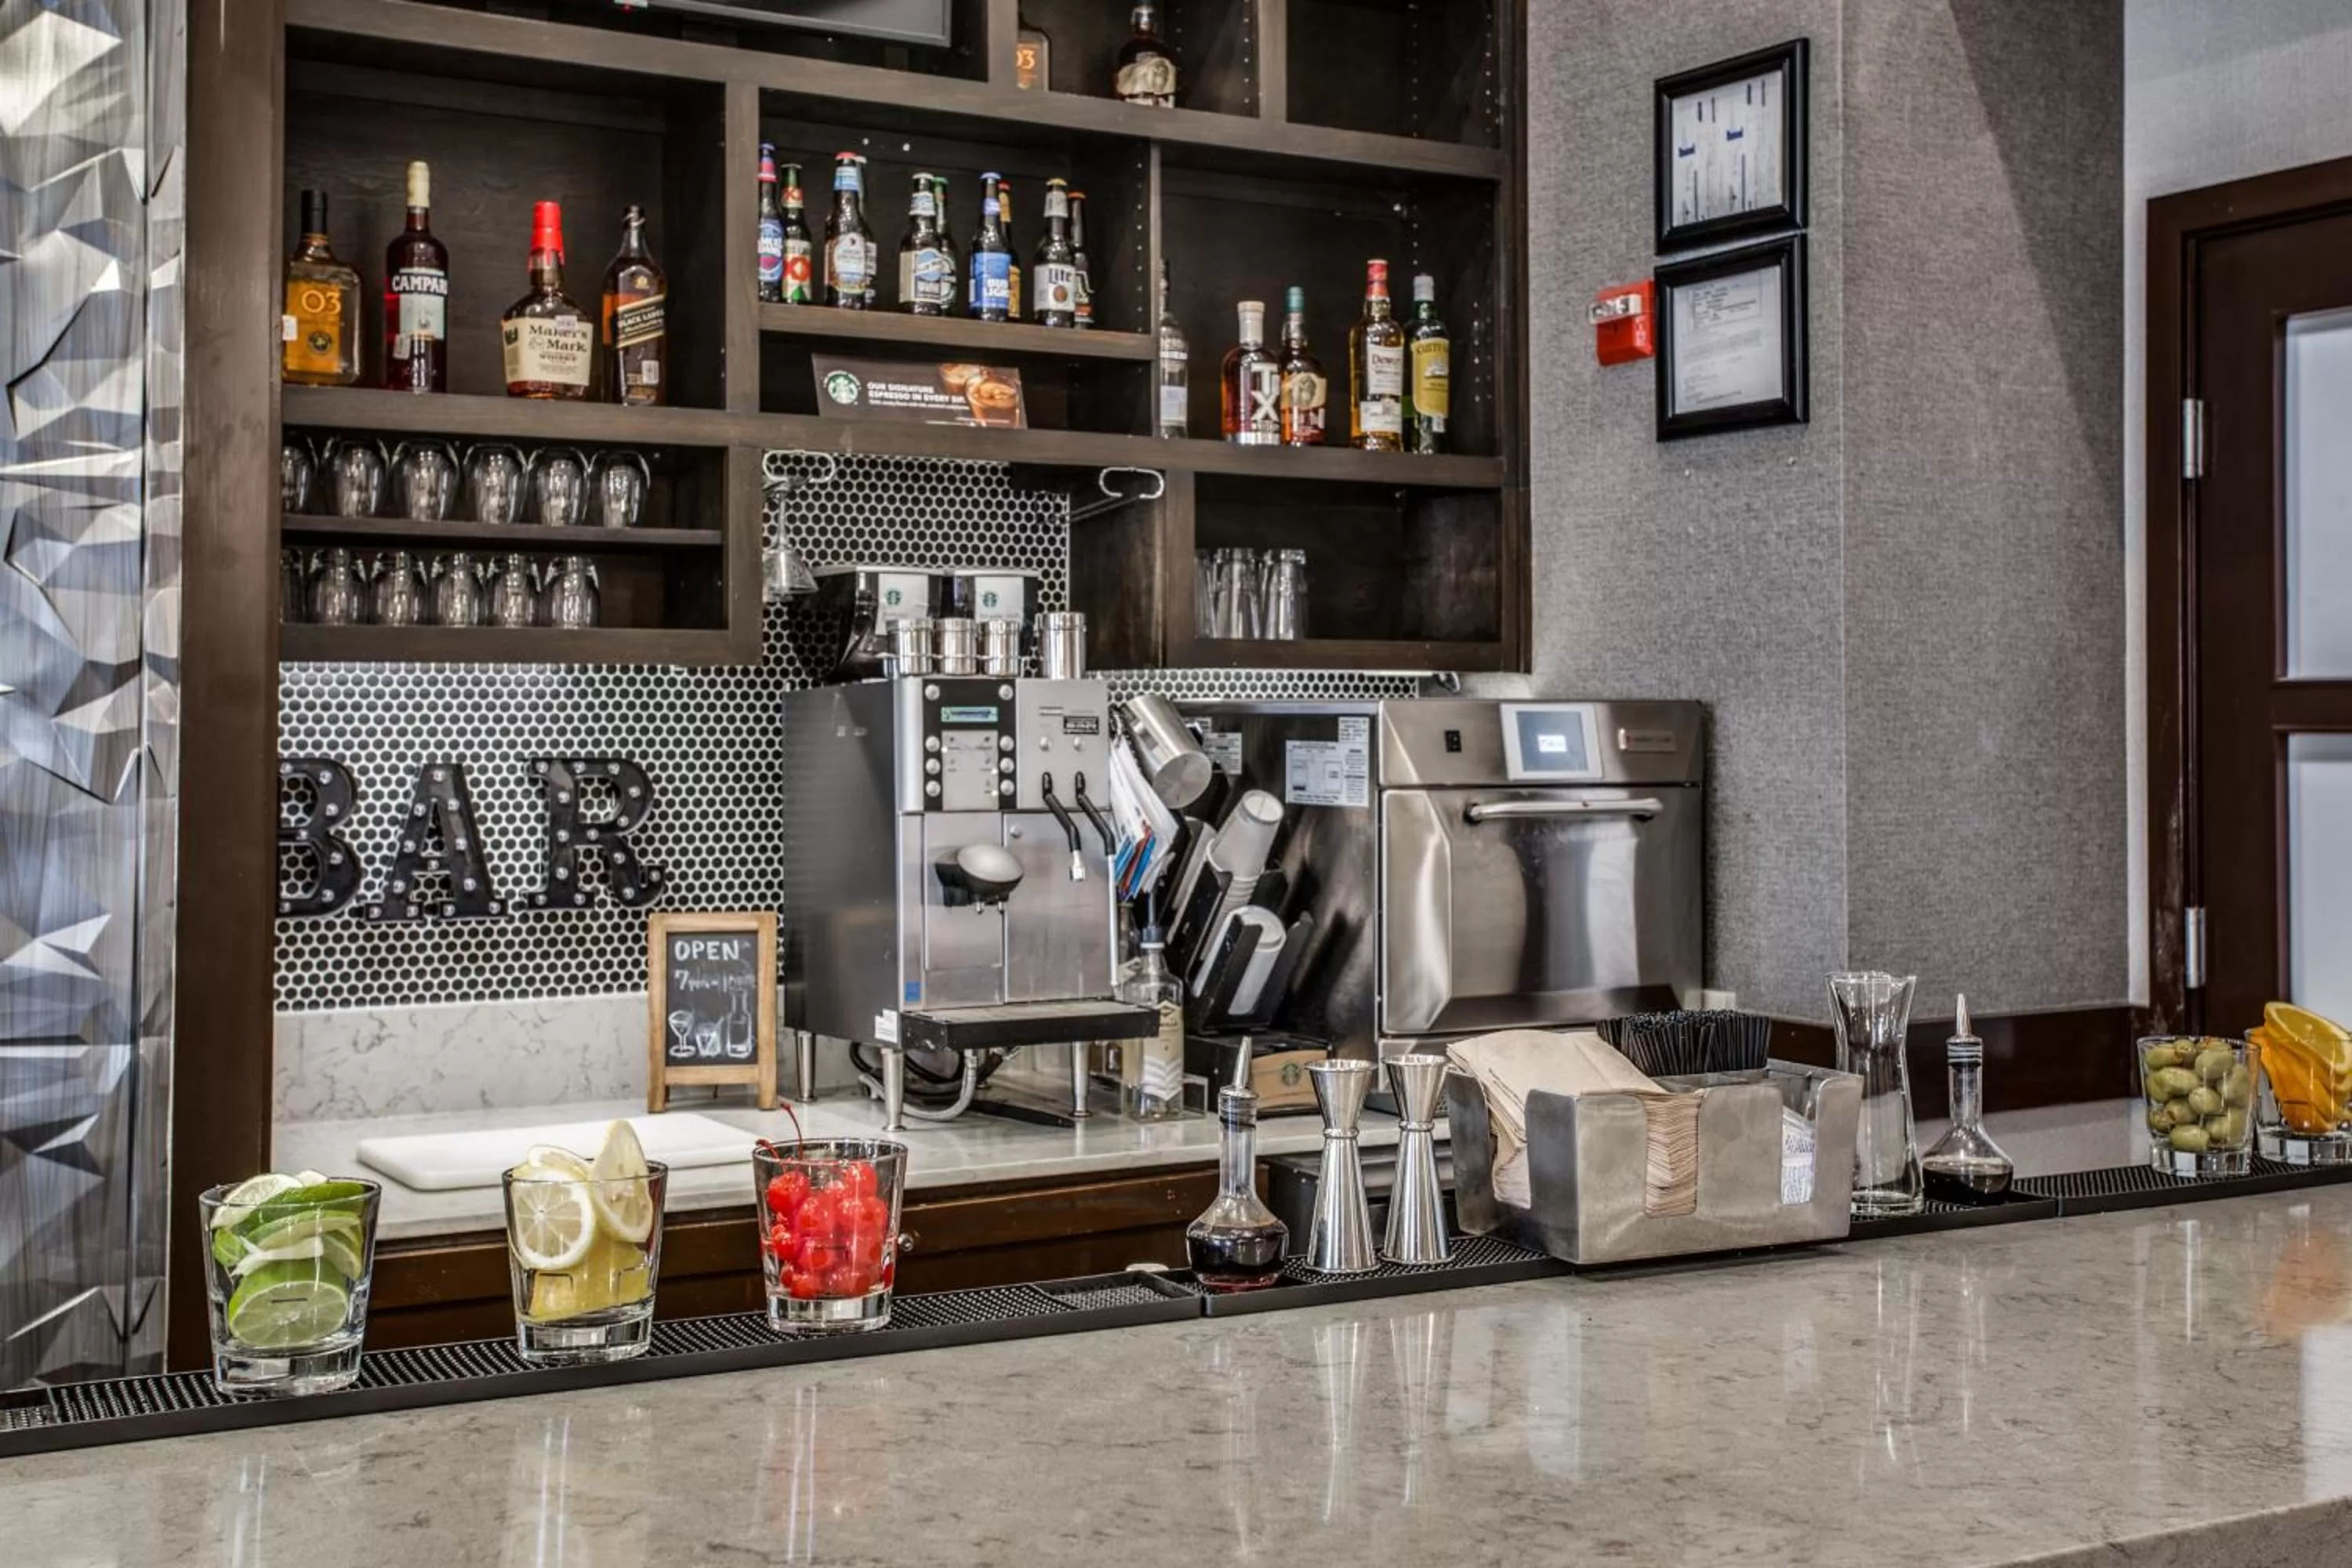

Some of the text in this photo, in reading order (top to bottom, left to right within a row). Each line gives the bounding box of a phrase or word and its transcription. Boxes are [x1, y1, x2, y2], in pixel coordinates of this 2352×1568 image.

[1047, 268, 1073, 284] Lite
[869, 390, 911, 401] ESPRESSO
[924, 393, 949, 403] EVERY
[277, 757, 666, 924] BAR
[674, 939, 739, 961] OPEN
